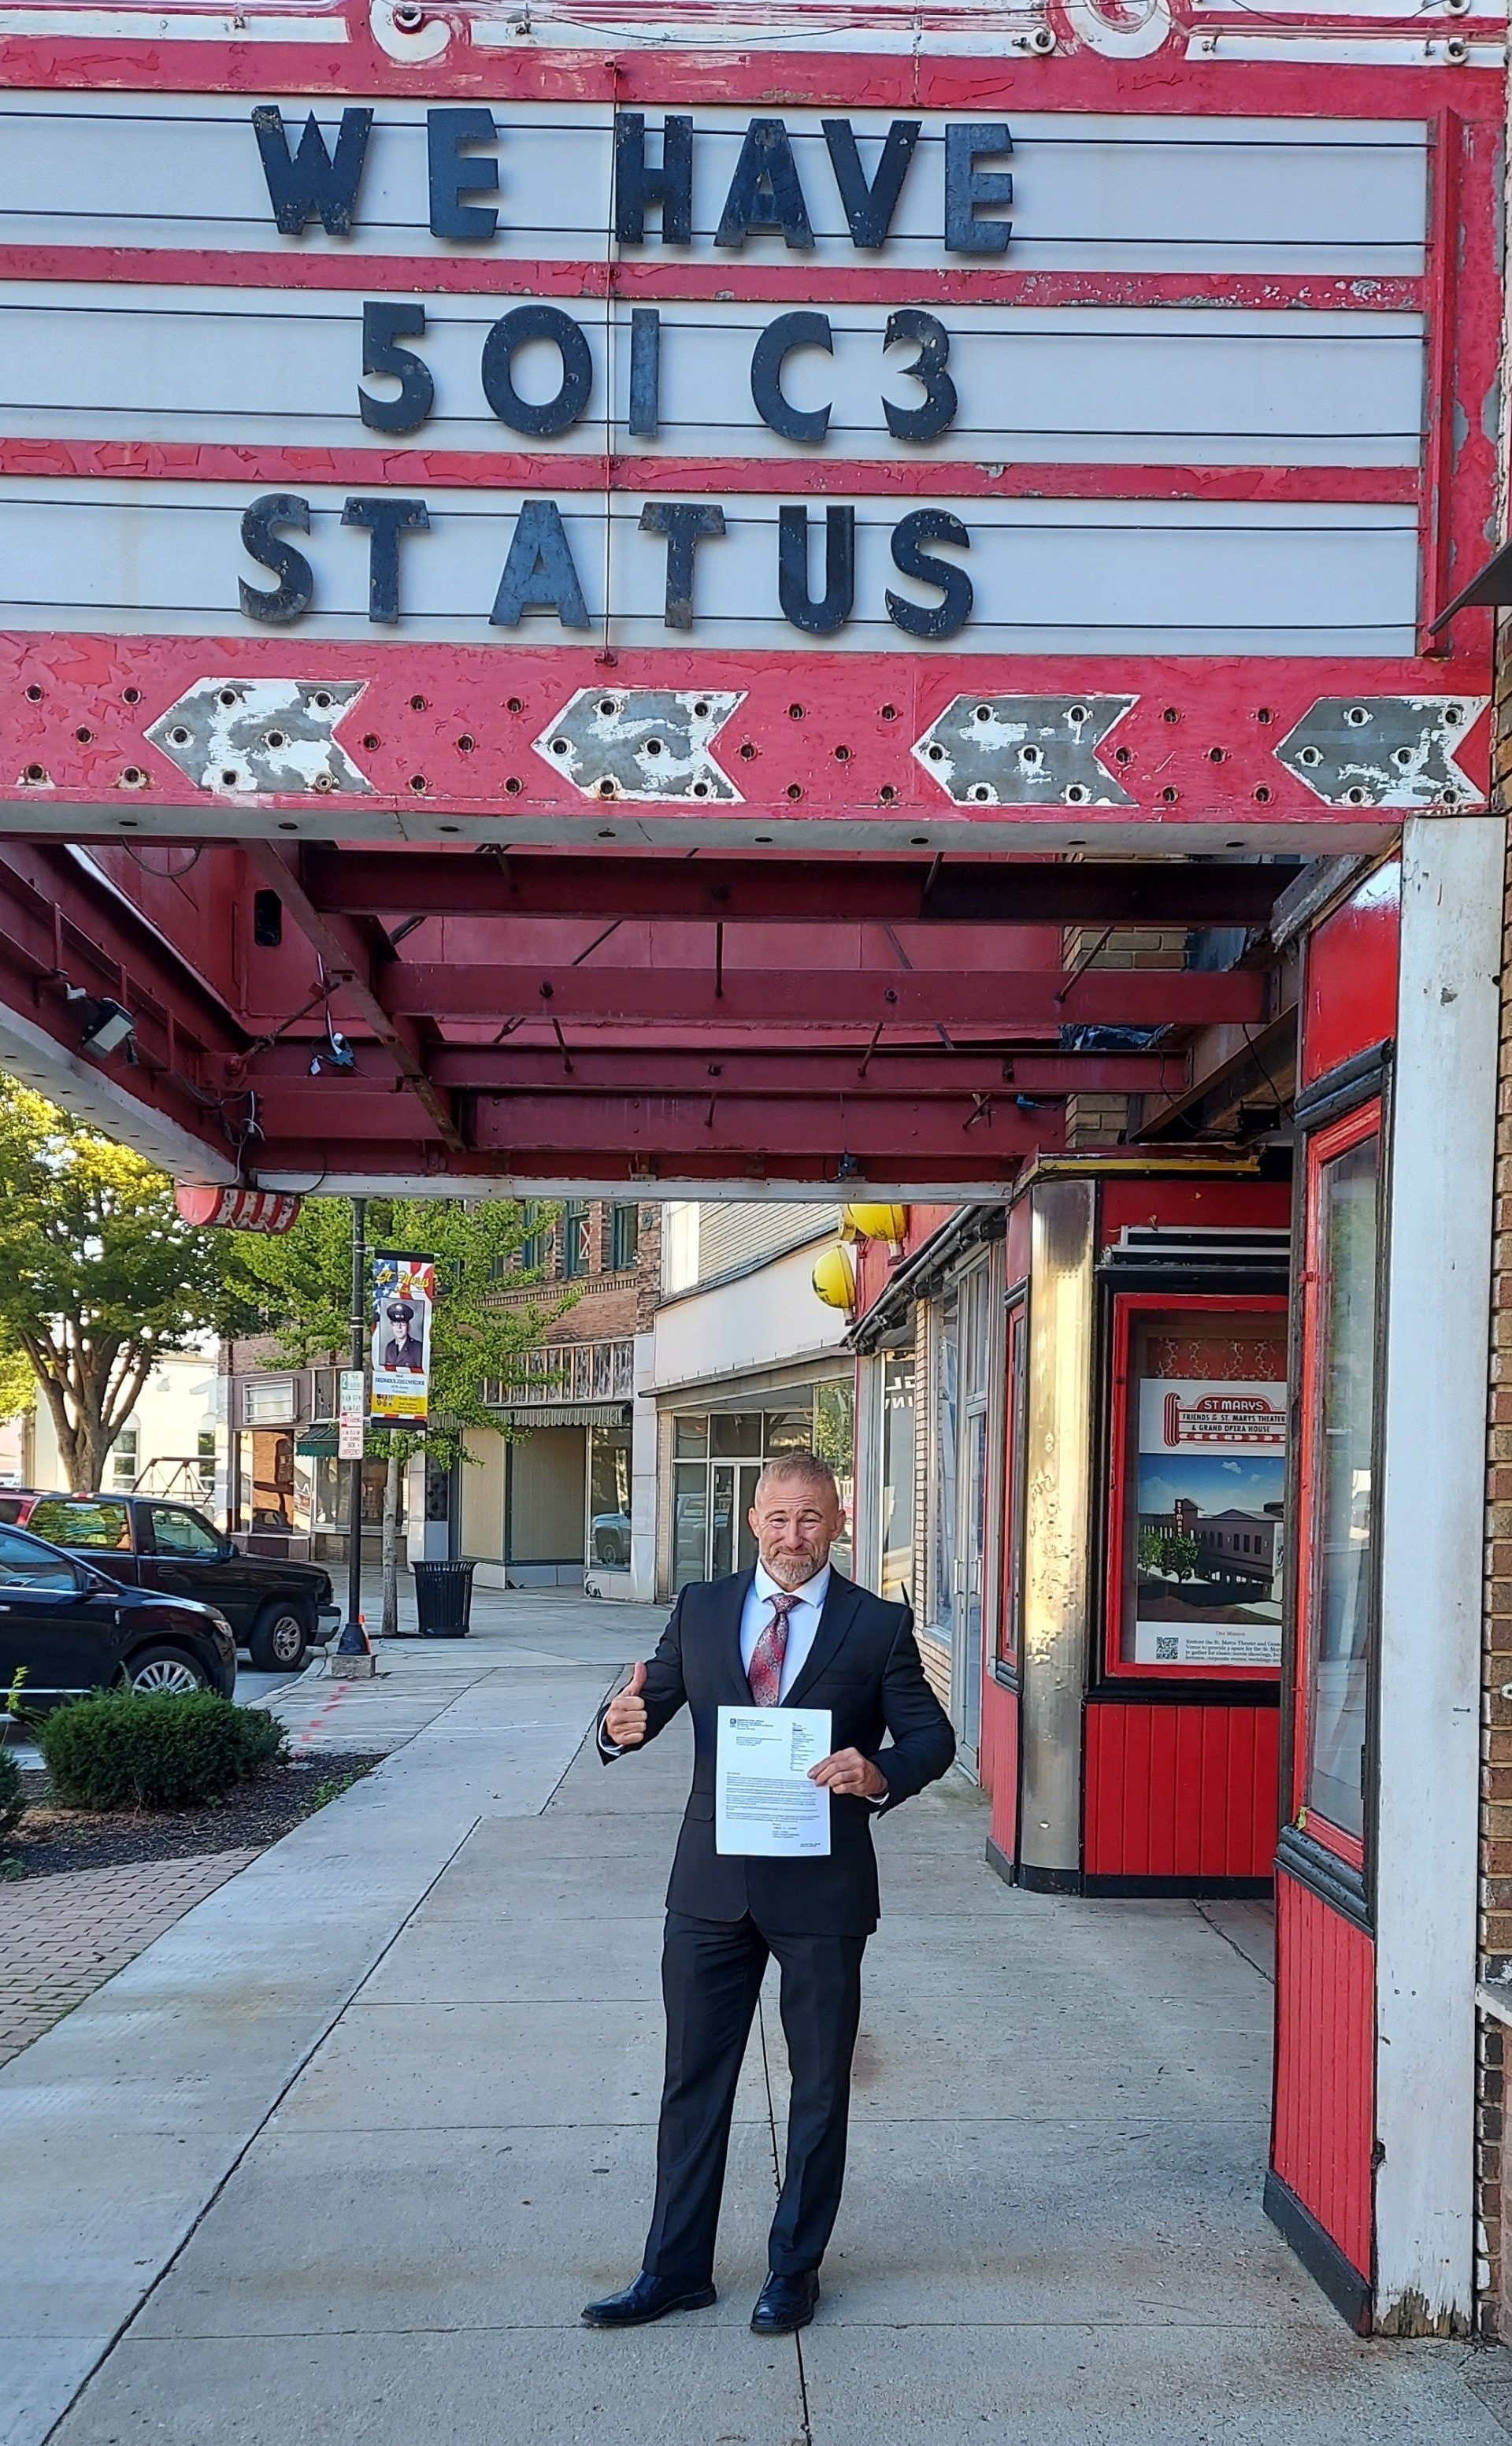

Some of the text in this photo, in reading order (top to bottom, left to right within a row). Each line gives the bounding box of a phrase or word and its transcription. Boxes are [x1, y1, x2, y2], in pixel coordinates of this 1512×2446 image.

[254, 106, 1014, 255] WE HAVE
[750, 309, 958, 444] C3
[238, 493, 973, 641] STATUS
[1204, 1399, 1264, 1410] ST MARYS
